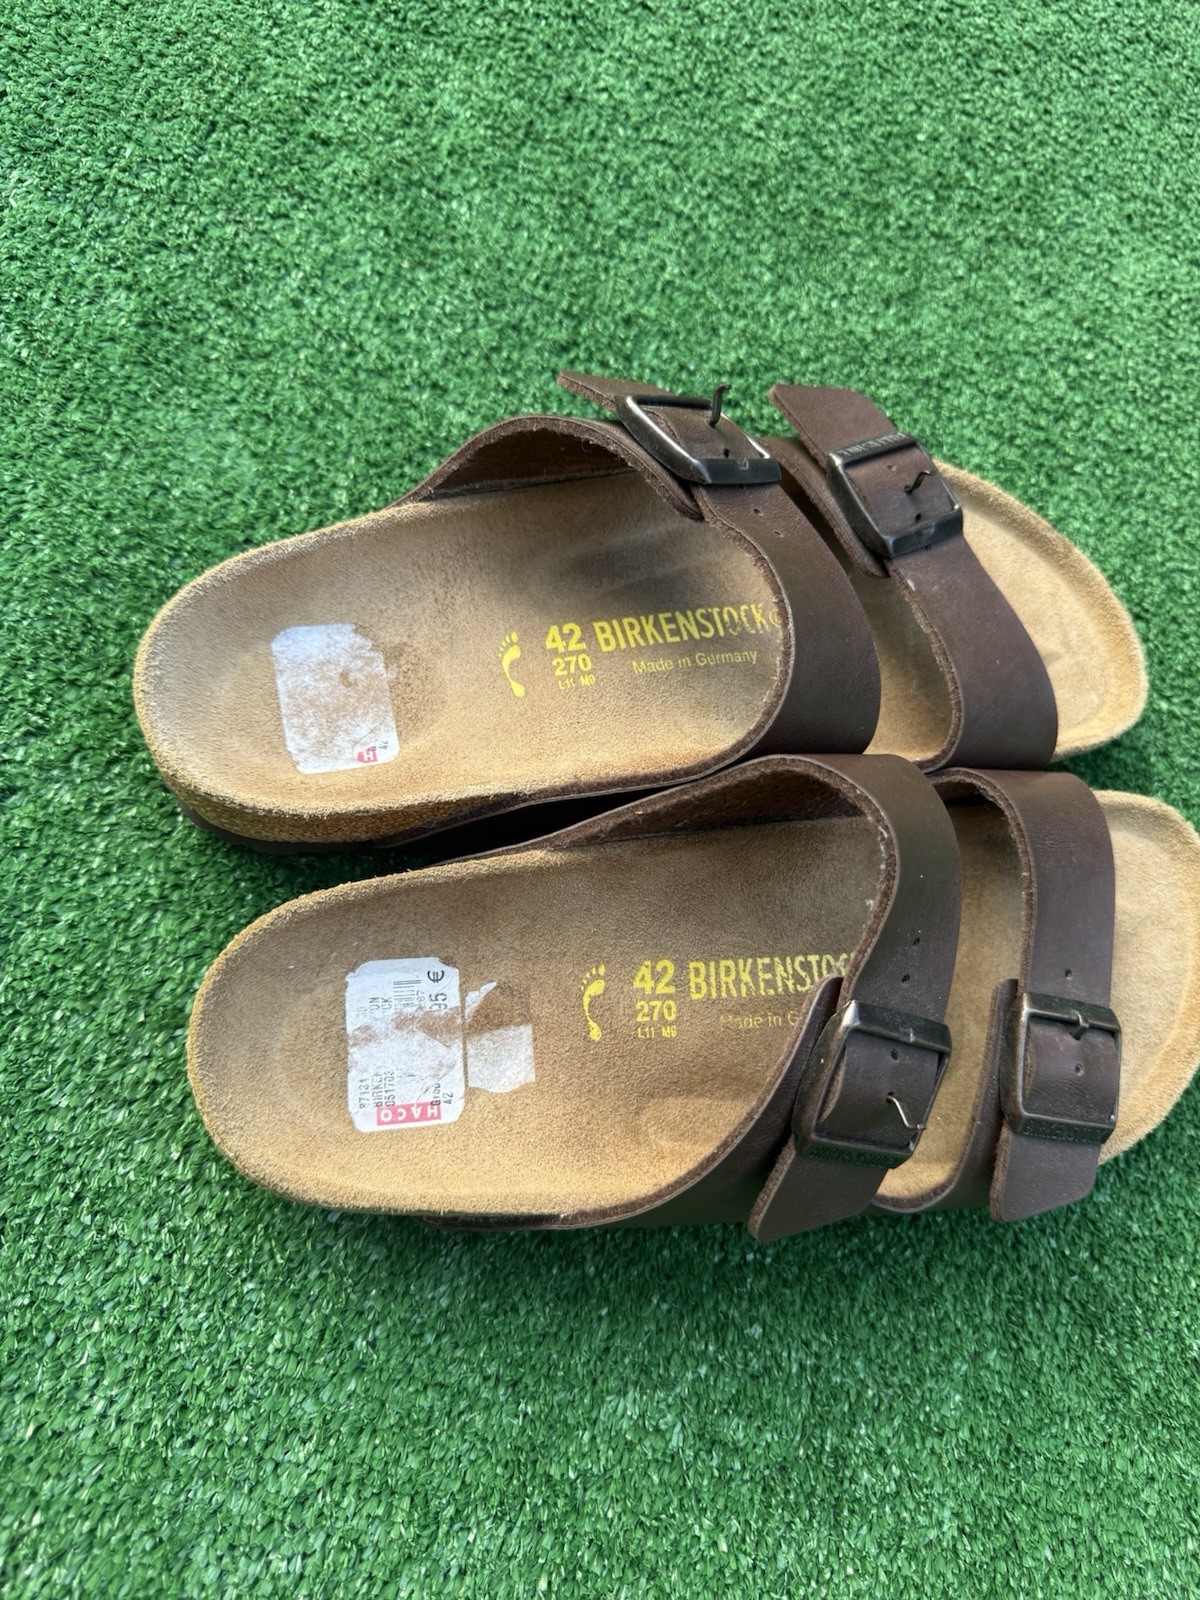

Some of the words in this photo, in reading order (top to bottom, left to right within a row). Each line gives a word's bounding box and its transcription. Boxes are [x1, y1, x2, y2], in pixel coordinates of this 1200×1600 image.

[545, 622, 587, 654] 42
[593, 604, 771, 653] BIRKENSTOCK
[552, 653, 593, 677] 270
[631, 660, 674, 675] Made
[678, 657, 692, 669] in
[695, 650, 758, 667] Germany
[632, 958, 676, 995] 42
[635, 1000, 677, 1022] 270
[379, 1104, 439, 1123] HACO
